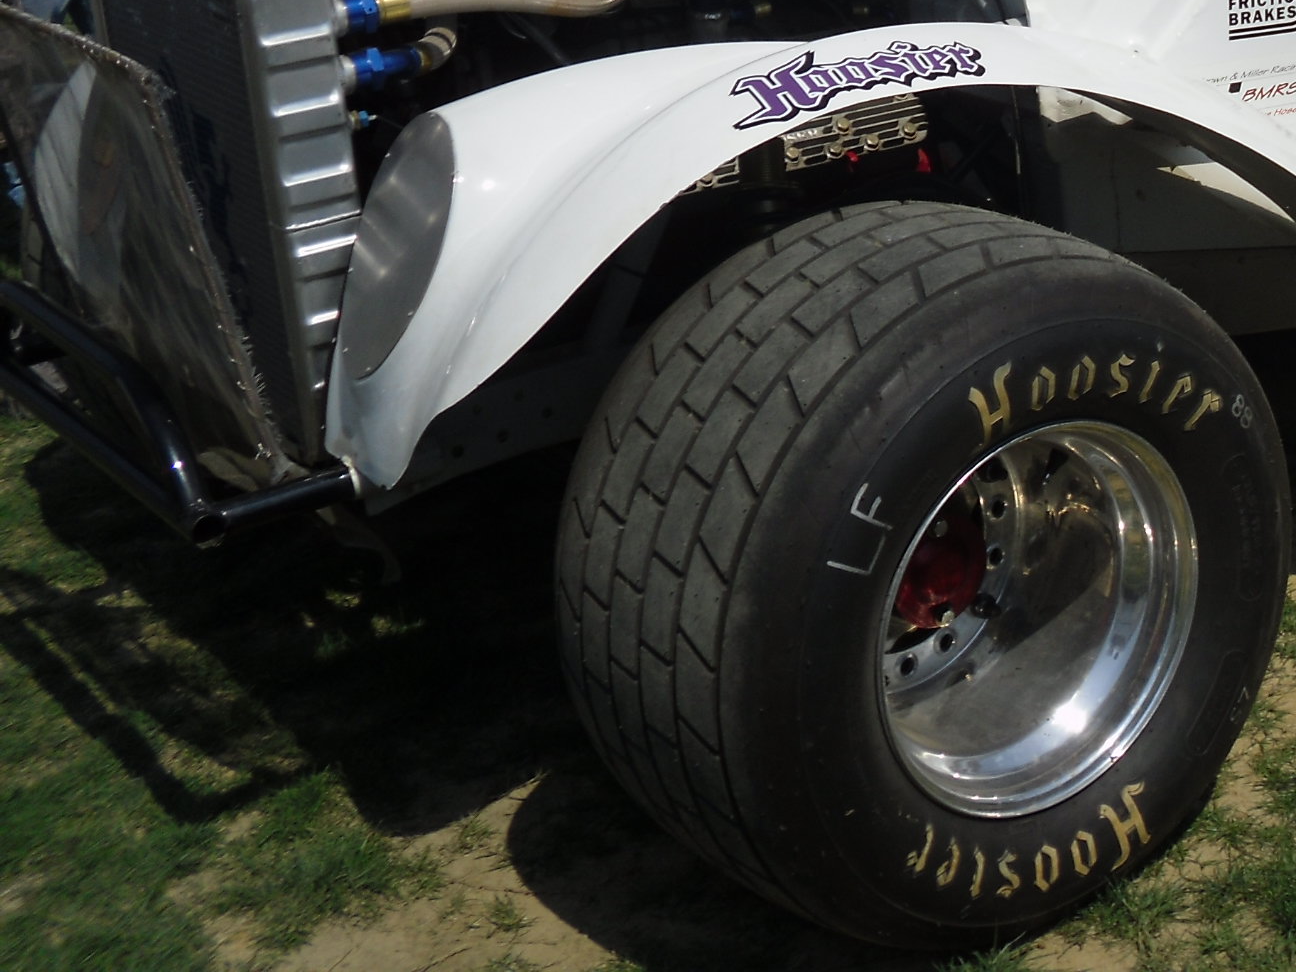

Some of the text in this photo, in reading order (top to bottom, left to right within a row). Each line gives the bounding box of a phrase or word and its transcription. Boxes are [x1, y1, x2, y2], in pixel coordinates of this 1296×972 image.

[1228, 5, 1296, 26] BRAKES
[728, 41, 987, 131] Hoosier
[1240, 68, 1269, 79] Miller
[968, 340, 1225, 447] Hoosier
[826, 482, 893, 575] LF
[904, 780, 1151, 905] Hoosier
